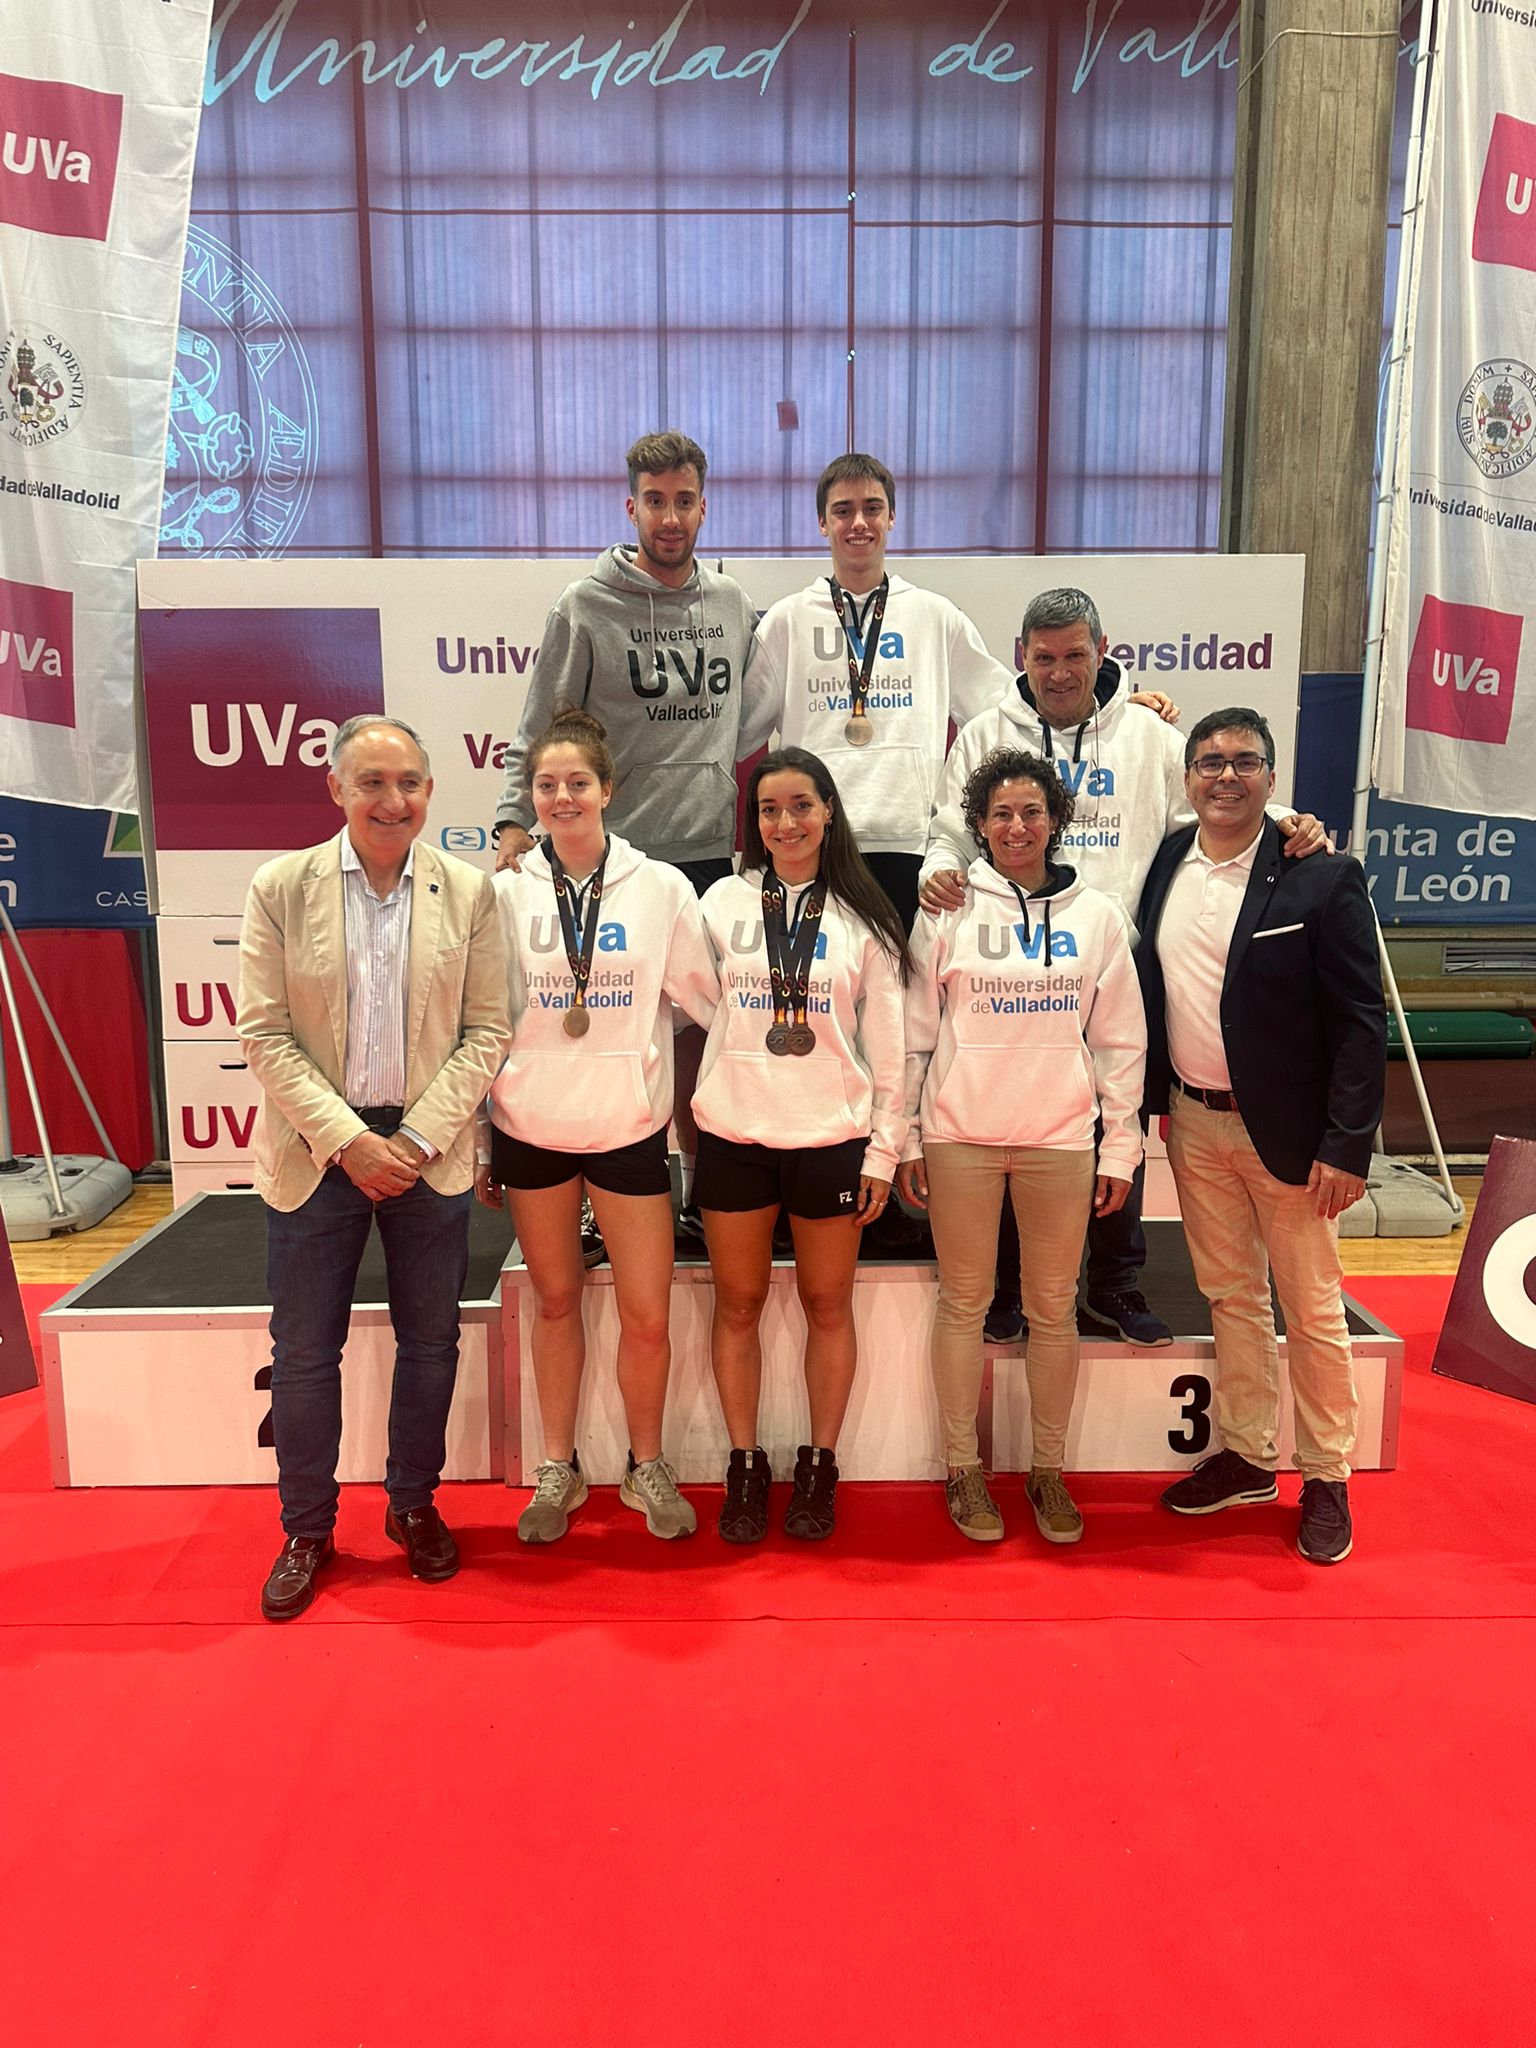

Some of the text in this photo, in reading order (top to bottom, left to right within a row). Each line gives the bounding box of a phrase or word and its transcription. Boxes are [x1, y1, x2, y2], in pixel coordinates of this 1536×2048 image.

[1471, 0, 1536, 29] Universi
[928, 0, 1034, 83] de
[3, 131, 92, 185] UVa
[1506, 172, 1536, 215] U
[630, 624, 725, 643] Universidad
[436, 637, 540, 674] Univ
[627, 647, 731, 699] UVa
[1432, 649, 1501, 696] UVa
[1456, 820, 1516, 857] de
[1395, 864, 1512, 902] León
[977, 923, 1079, 960] UVa
[839, 1191, 853, 1204] FZ
[1168, 1374, 1212, 1454] 3
